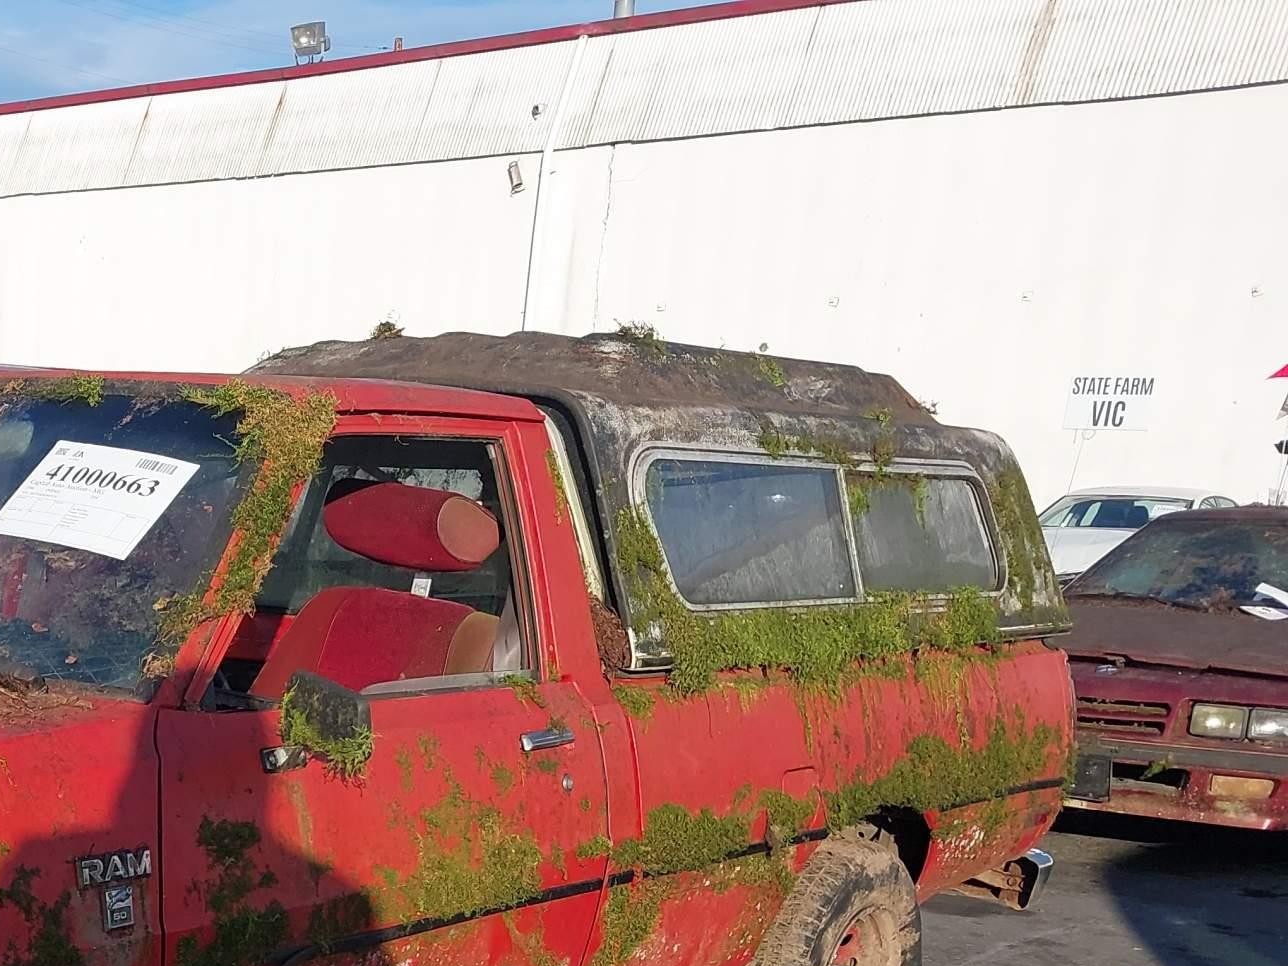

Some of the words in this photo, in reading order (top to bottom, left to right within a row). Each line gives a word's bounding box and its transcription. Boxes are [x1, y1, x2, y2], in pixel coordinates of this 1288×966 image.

[1072, 377, 1111, 395] STATE
[1113, 377, 1155, 396] FARM
[1091, 400, 1126, 427] VIC
[45, 463, 161, 497] 41000663
[79, 848, 153, 886] RAM
